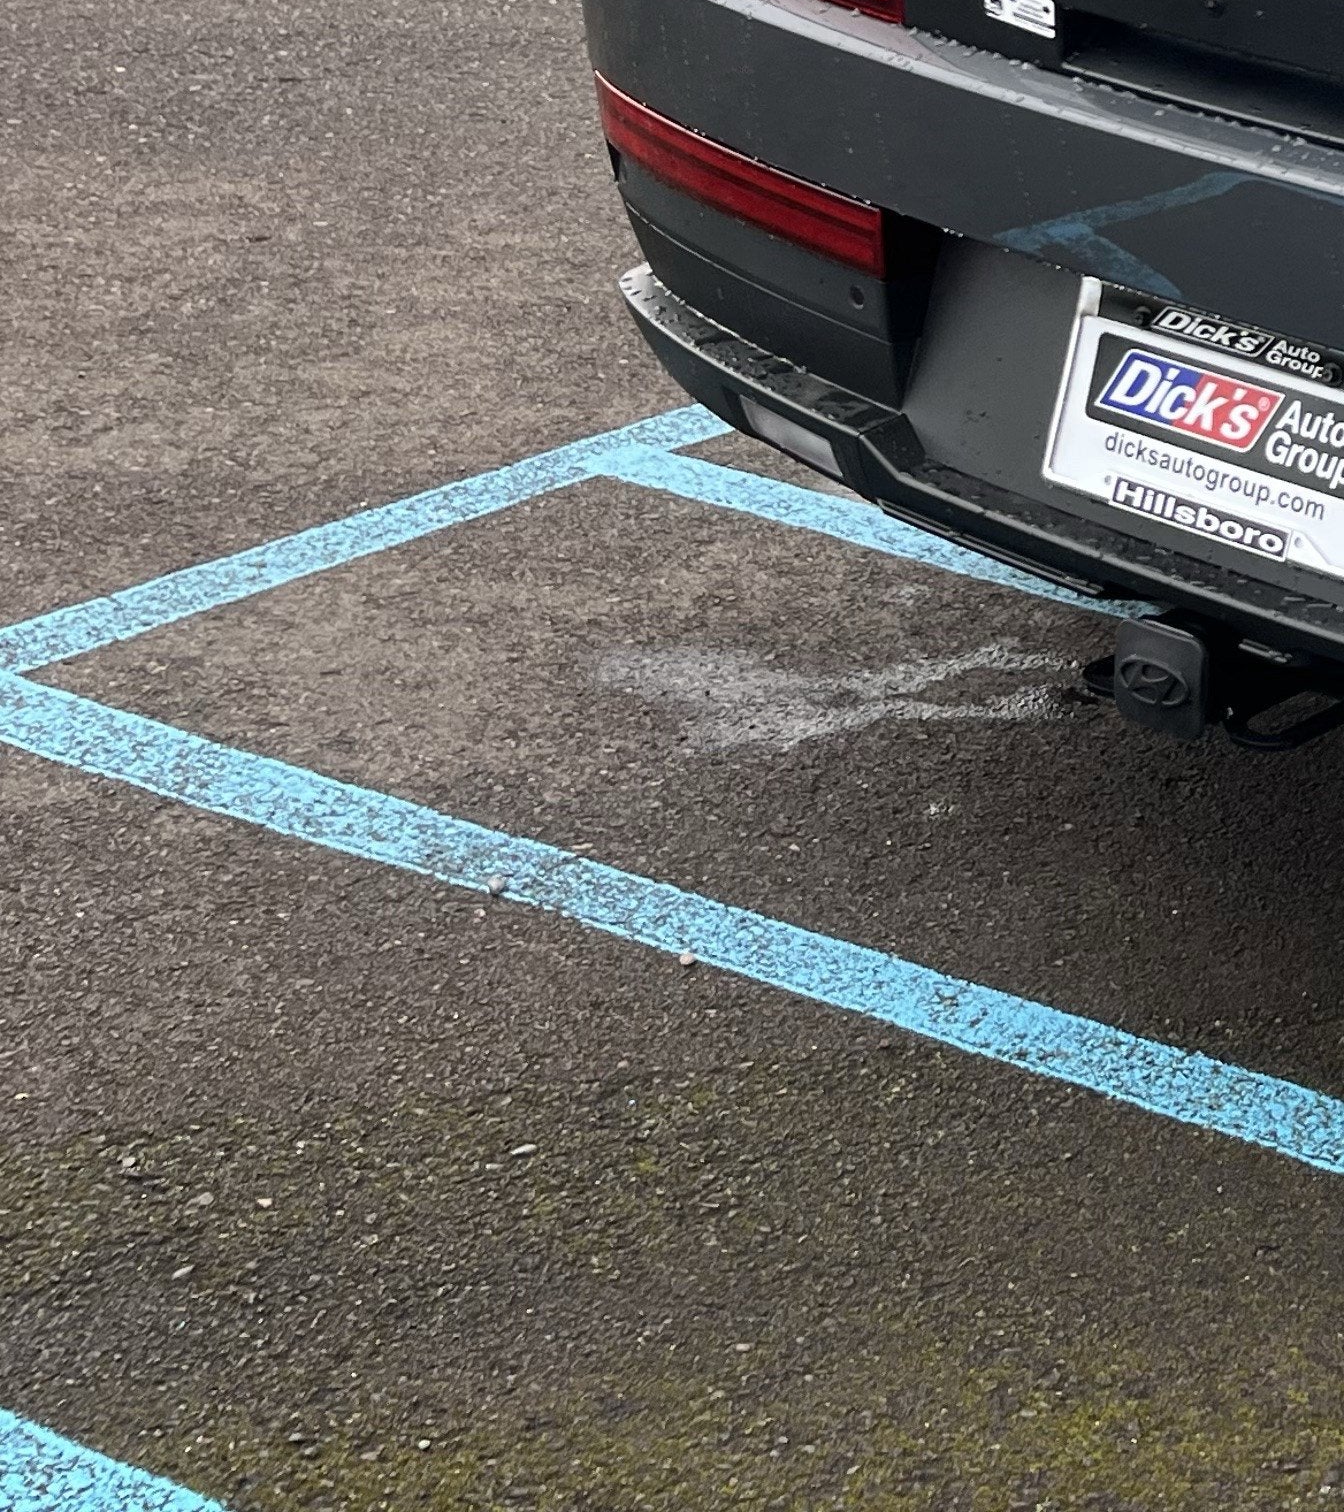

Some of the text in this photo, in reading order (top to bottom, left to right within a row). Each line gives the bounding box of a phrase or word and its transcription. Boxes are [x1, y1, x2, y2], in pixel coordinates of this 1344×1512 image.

[1161, 310, 1263, 355] Dick's
[1273, 339, 1321, 363] Auto
[1265, 351, 1325, 380] Group
[1108, 359, 1260, 441] Dick's
[1104, 432, 1326, 522] dicksautogroup.com
[1115, 477, 1285, 555] Hillsboro
